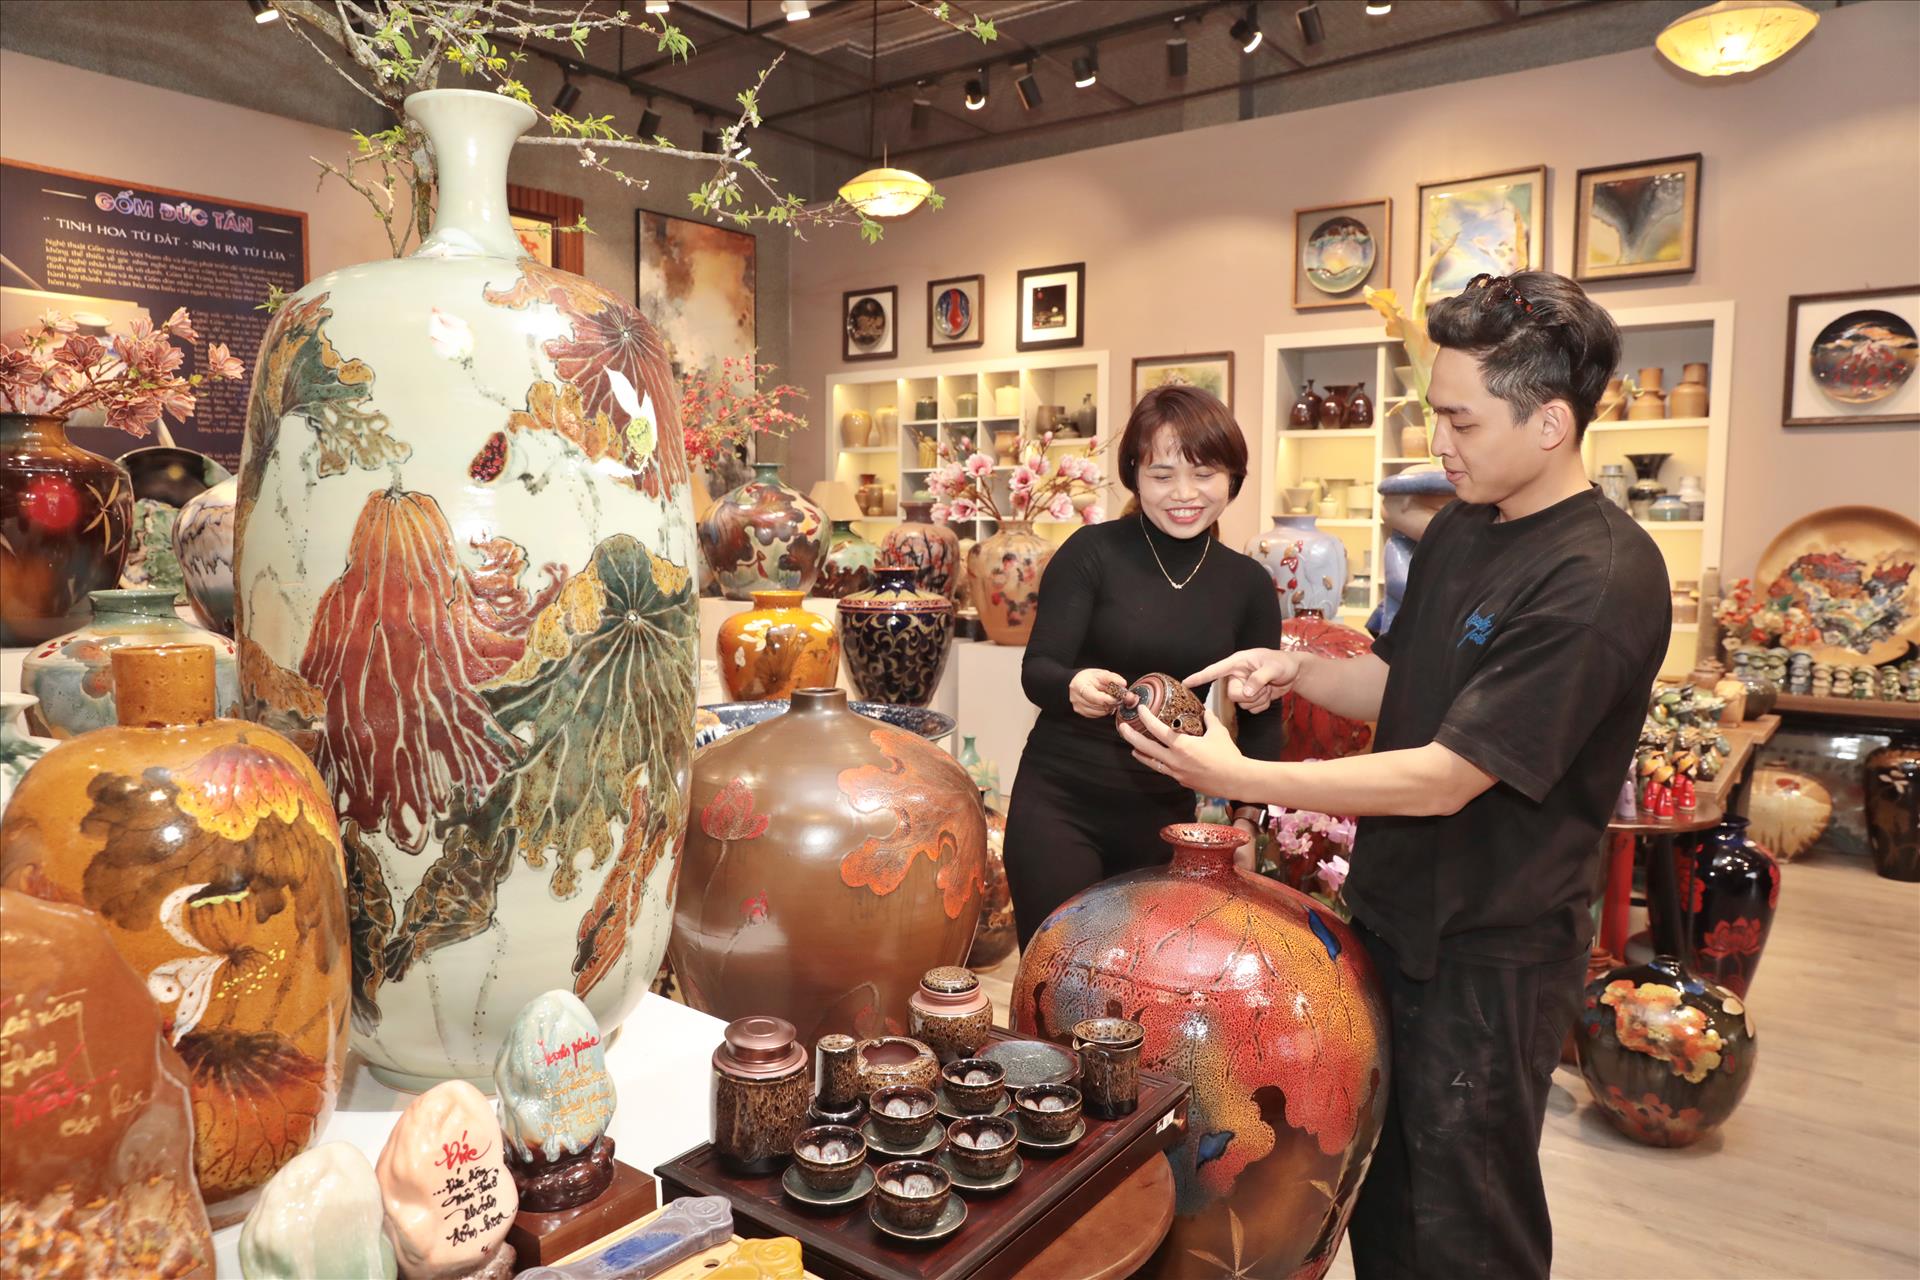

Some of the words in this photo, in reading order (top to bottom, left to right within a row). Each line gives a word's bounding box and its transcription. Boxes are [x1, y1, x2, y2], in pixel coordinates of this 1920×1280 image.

[94, 190, 154, 219] GỐM
[159, 202, 208, 227] ĐỨC
[212, 209, 254, 234] TÂN
[56, 217, 92, 233] TINH
[97, 223, 127, 238] HOA
[192, 240, 221, 252] SINH
[224, 244, 239, 256] RA
[435, 1130, 492, 1170] Đức
